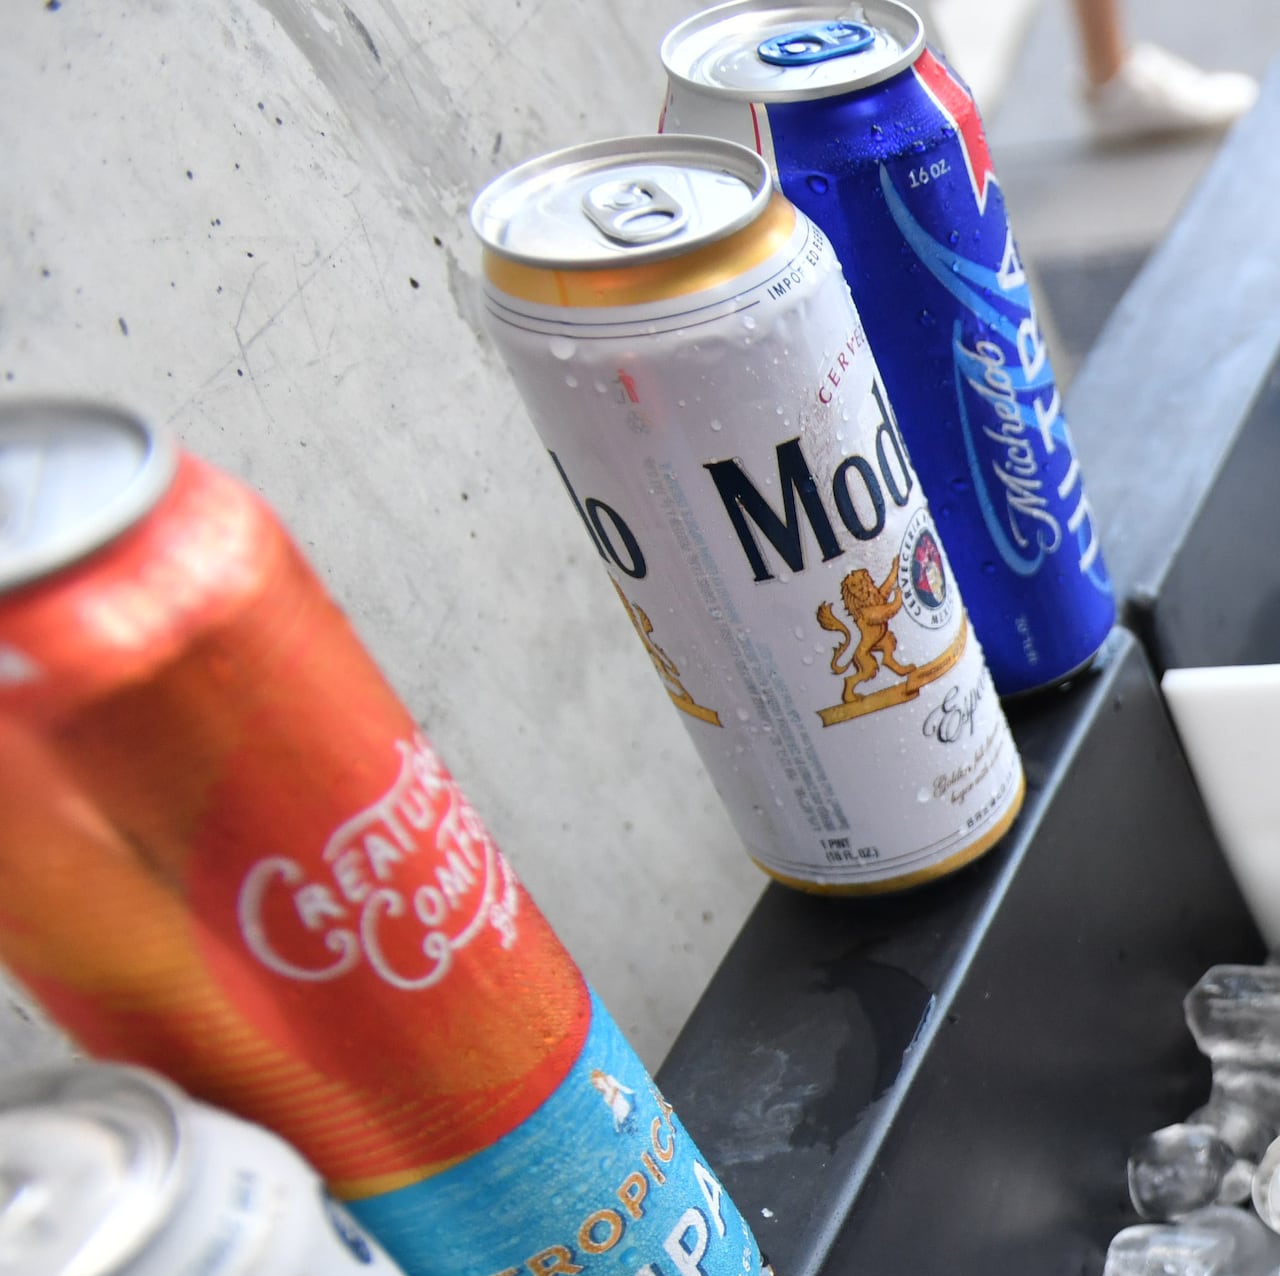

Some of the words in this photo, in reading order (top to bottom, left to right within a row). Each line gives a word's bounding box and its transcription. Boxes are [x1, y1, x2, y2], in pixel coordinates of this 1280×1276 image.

[908, 167, 930, 189] 16
[929, 158, 951, 182] oz.
[956, 338, 1062, 555] Michelob
